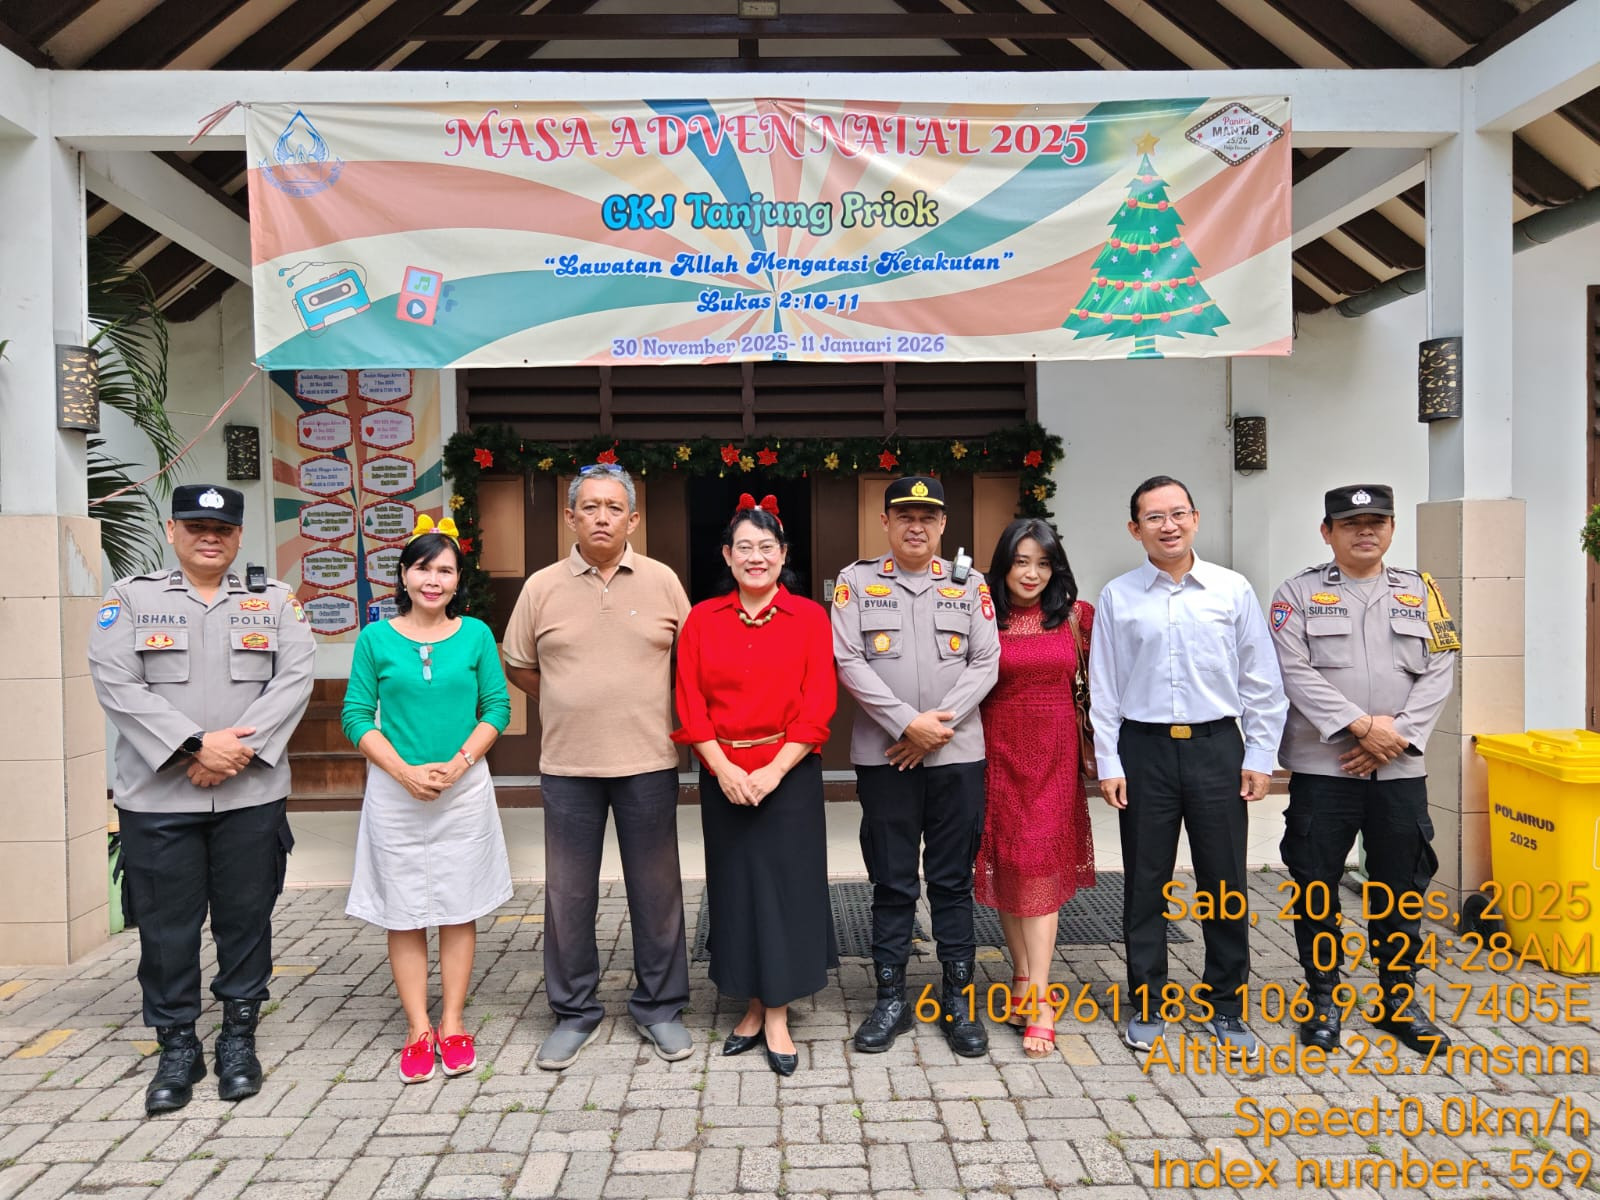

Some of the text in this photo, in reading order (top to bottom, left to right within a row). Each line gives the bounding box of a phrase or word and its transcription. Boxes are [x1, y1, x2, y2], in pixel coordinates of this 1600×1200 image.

[444, 109, 1088, 164] MASA ADVEN NATAL 2025
[1212, 124, 1260, 137] MANTAB
[601, 190, 940, 236] GKJ Tanjung Priok
[670, 253, 739, 277] Allah
[746, 250, 870, 277] Mengatasi
[696, 290, 861, 313] Lukas 2:10-11
[612, 339, 638, 356] 30
[643, 337, 736, 356] November
[801, 335, 814, 352] 11
[819, 335, 892, 353] Januari
[896, 335, 945, 353] 2026
[936, 601, 971, 612] POLRI
[1308, 606, 1348, 616] SULISTYO
[1391, 609, 1426, 621] POLRI
[229, 615, 277, 626] POLRI
[1494, 803, 1555, 833] POLAIRUD
[1510, 832, 1538, 851] 2025
